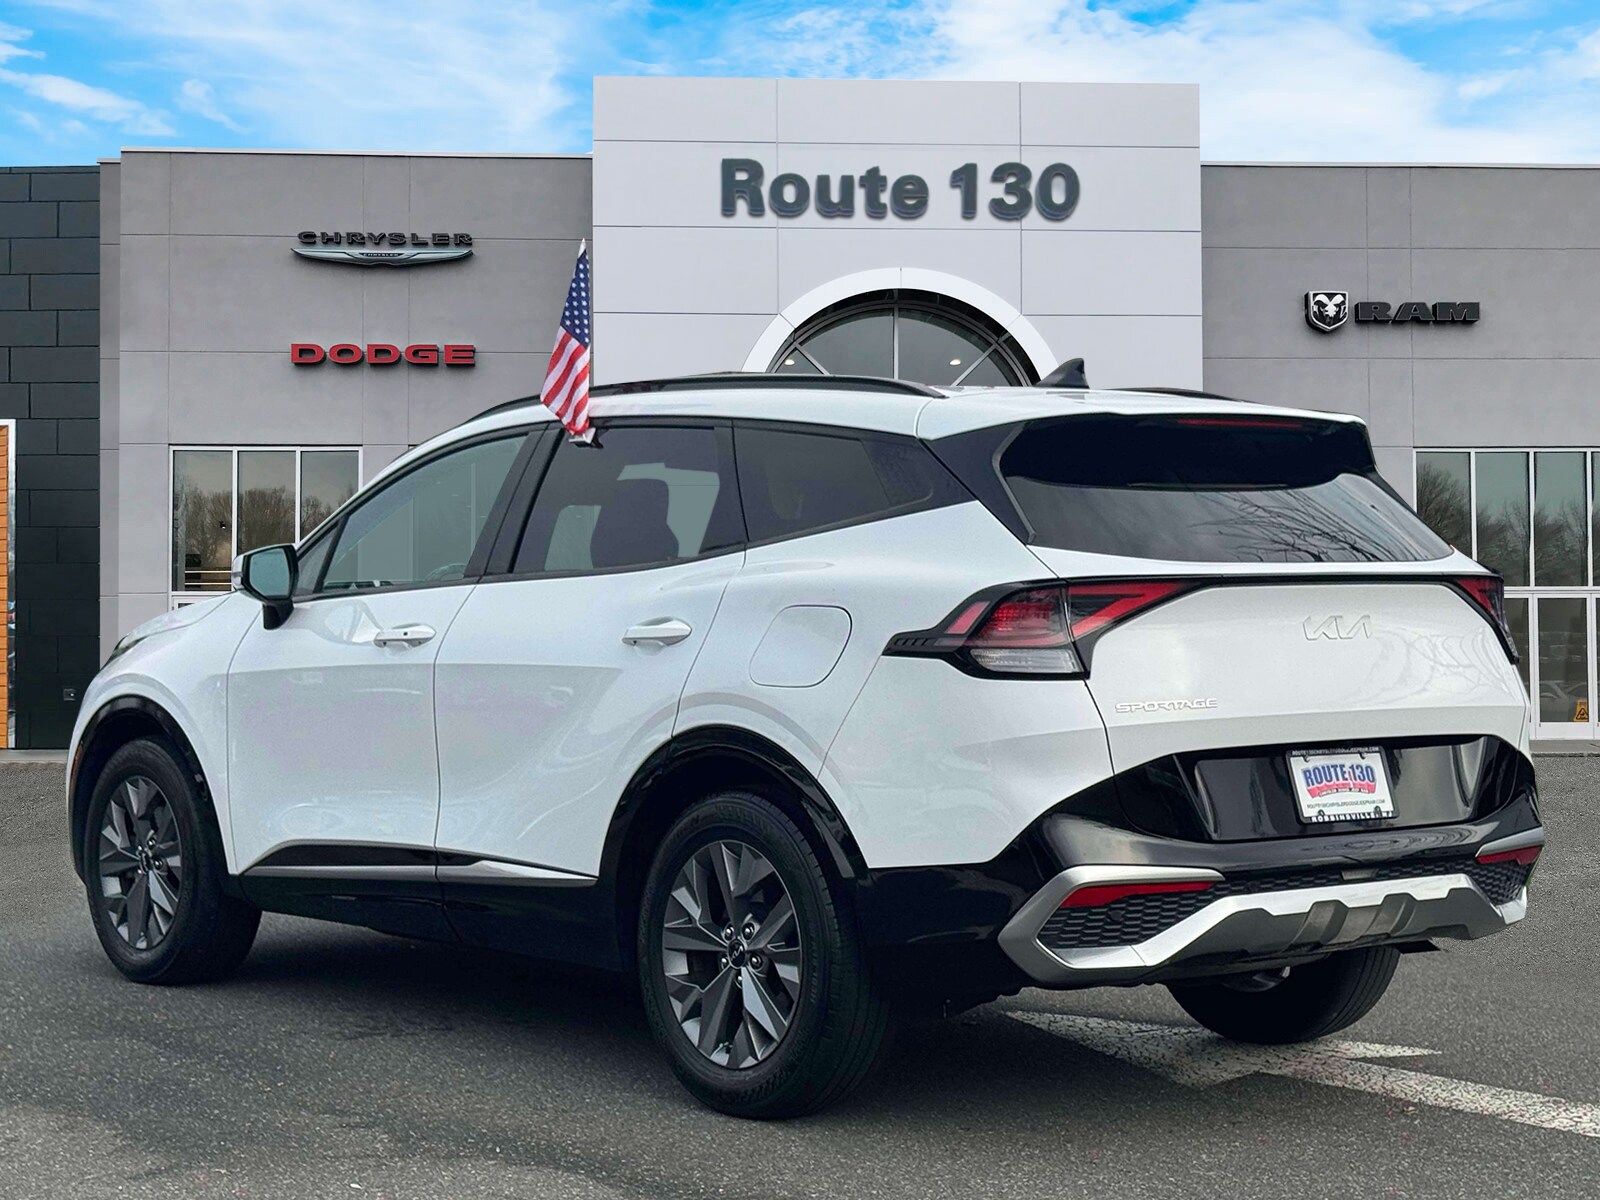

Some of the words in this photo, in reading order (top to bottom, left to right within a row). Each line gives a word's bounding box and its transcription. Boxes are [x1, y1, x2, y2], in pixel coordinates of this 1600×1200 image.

[721, 158, 929, 218] Route
[950, 162, 1080, 220] 130
[298, 231, 473, 245] CHRYSLER
[1354, 302, 1480, 324] RAM
[290, 343, 476, 367] DODGE
[1115, 697, 1218, 713] SPORTAGE
[1303, 764, 1348, 786] ROUTE
[1349, 764, 1375, 783] 130
